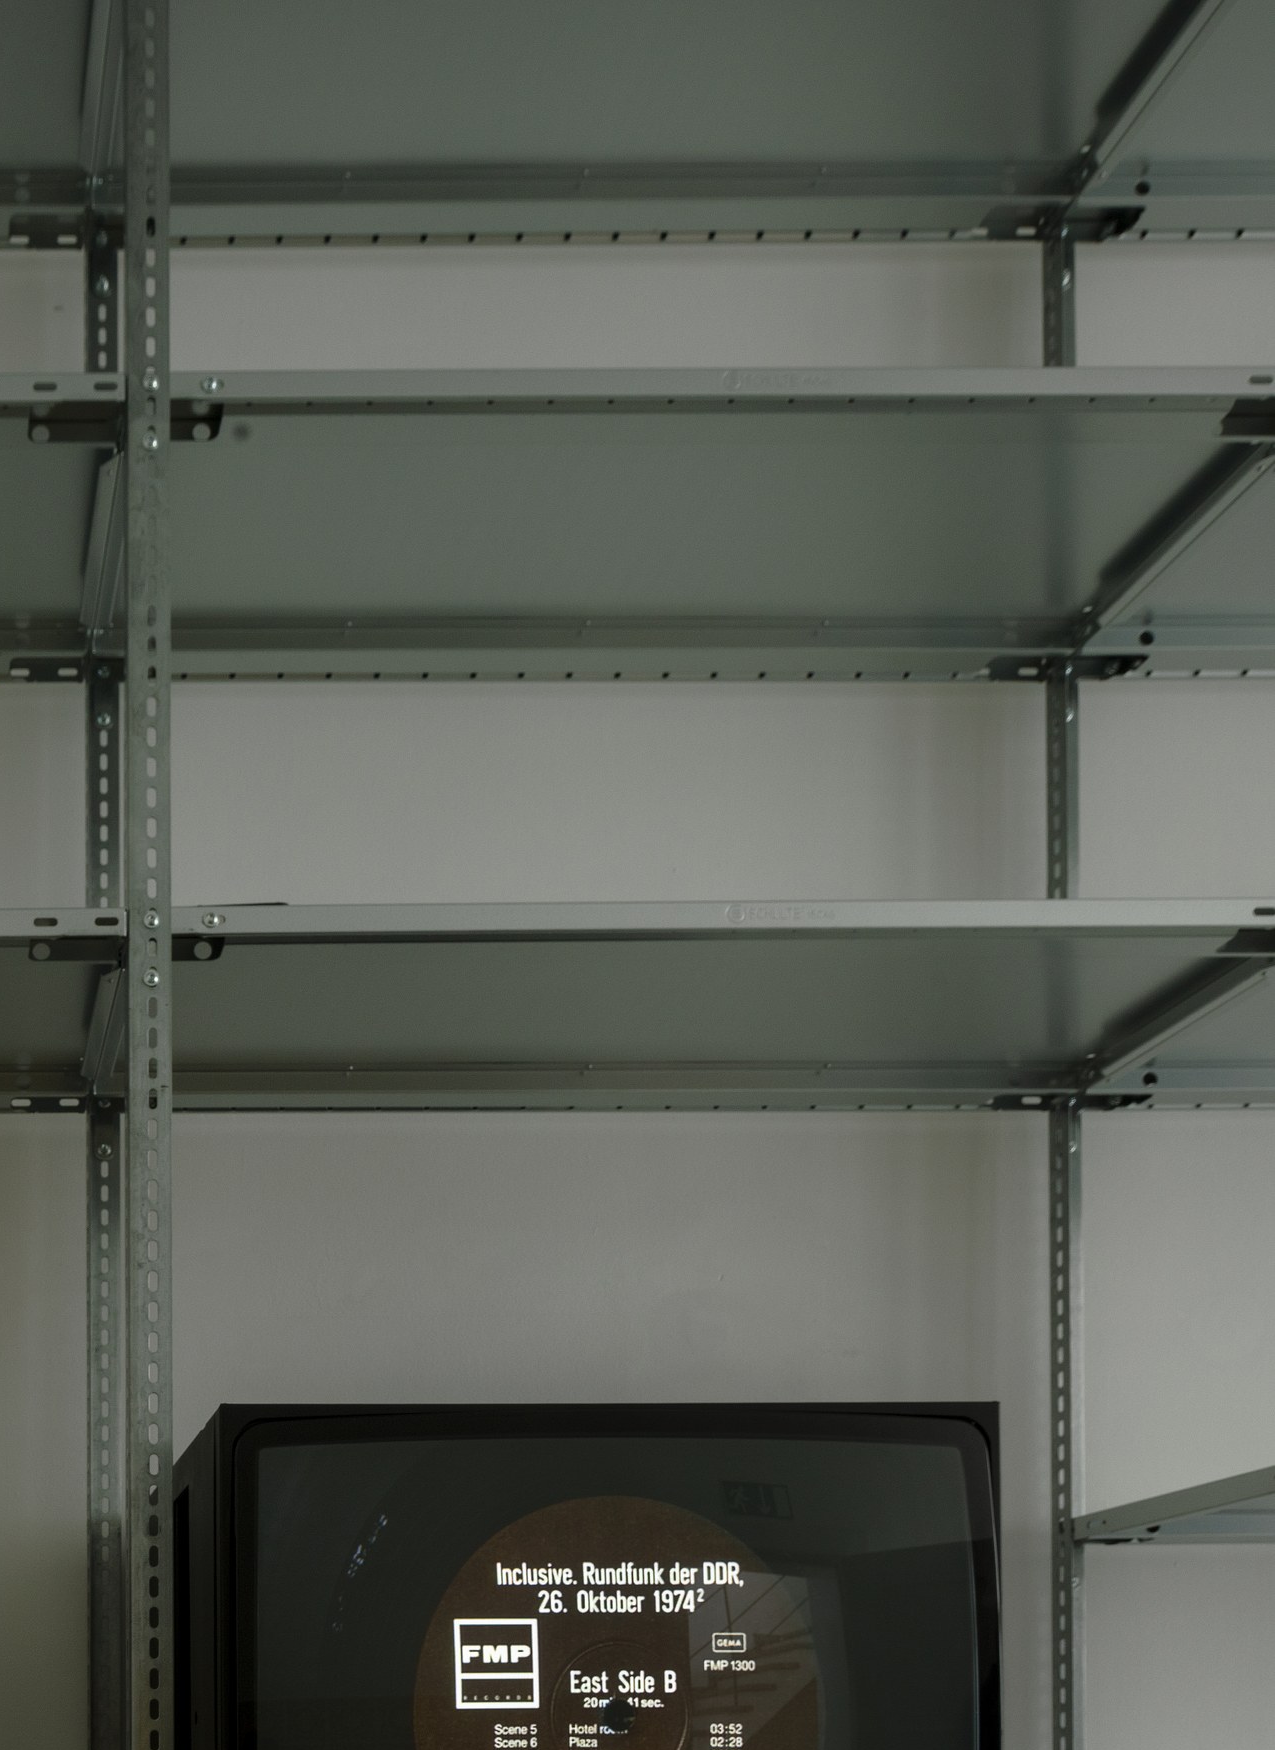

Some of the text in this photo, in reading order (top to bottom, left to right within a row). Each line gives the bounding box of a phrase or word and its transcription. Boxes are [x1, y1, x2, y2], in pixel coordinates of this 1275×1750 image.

[497, 1562, 744, 1589] Inclusive. Rundfunk der DDR,
[538, 1590, 567, 1613] 26.
[577, 1590, 645, 1613] Oktober
[717, 1639, 741, 1647] GEMA
[462, 1645, 530, 1663] FMP
[704, 1660, 755, 1671] FMP 1300
[570, 1670, 676, 1693] East Side B
[583, 1697, 598, 1708] 20
[640, 1698, 665, 1708] sec.
[494, 1724, 528, 1734] Scene
[530, 1724, 538, 1734] 5
[569, 1724, 597, 1734] Hotel
[710, 1724, 743, 1734] 03:52
[494, 1738, 743, 1748] Scene 6 Plaza 02:28
